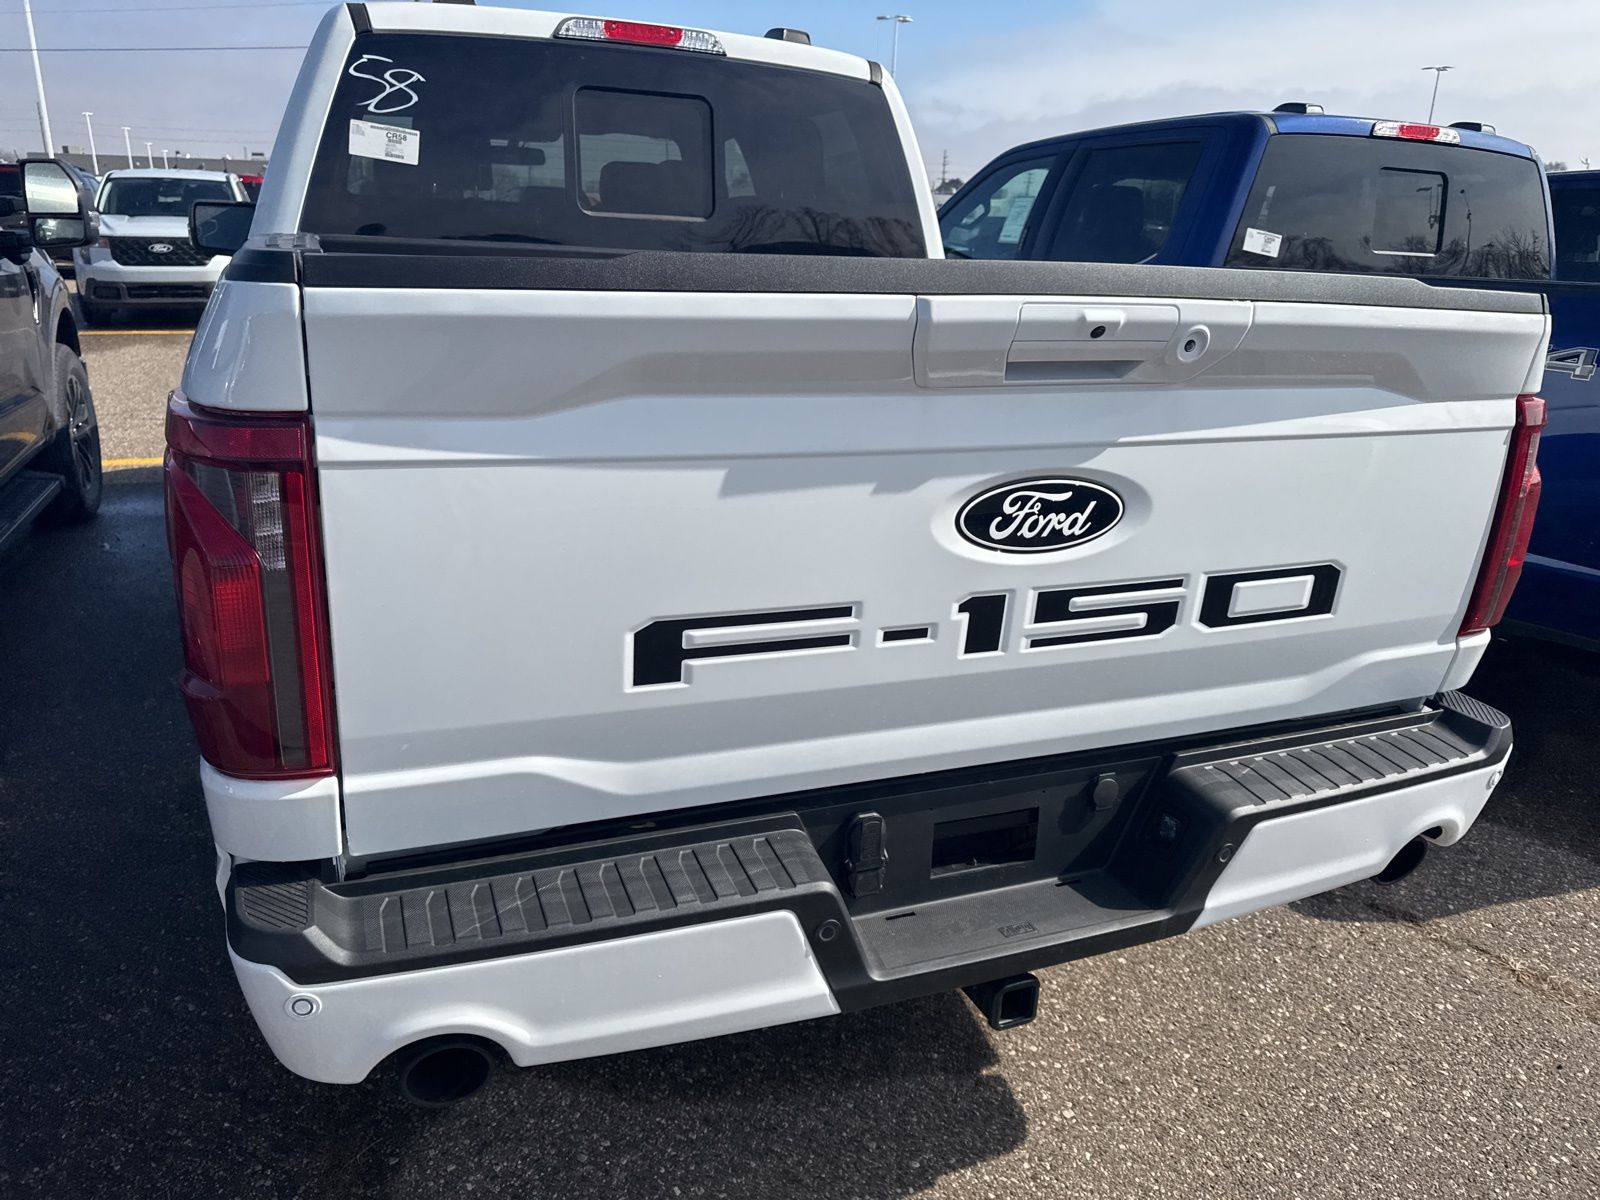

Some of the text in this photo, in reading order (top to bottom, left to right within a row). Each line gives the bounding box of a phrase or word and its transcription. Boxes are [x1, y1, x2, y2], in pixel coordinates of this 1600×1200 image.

[349, 54, 426, 114] 58
[385, 131, 408, 142] CR58
[1545, 345, 1600, 381] 4
[988, 490, 1096, 540] Ford
[631, 562, 1343, 687] F-150
